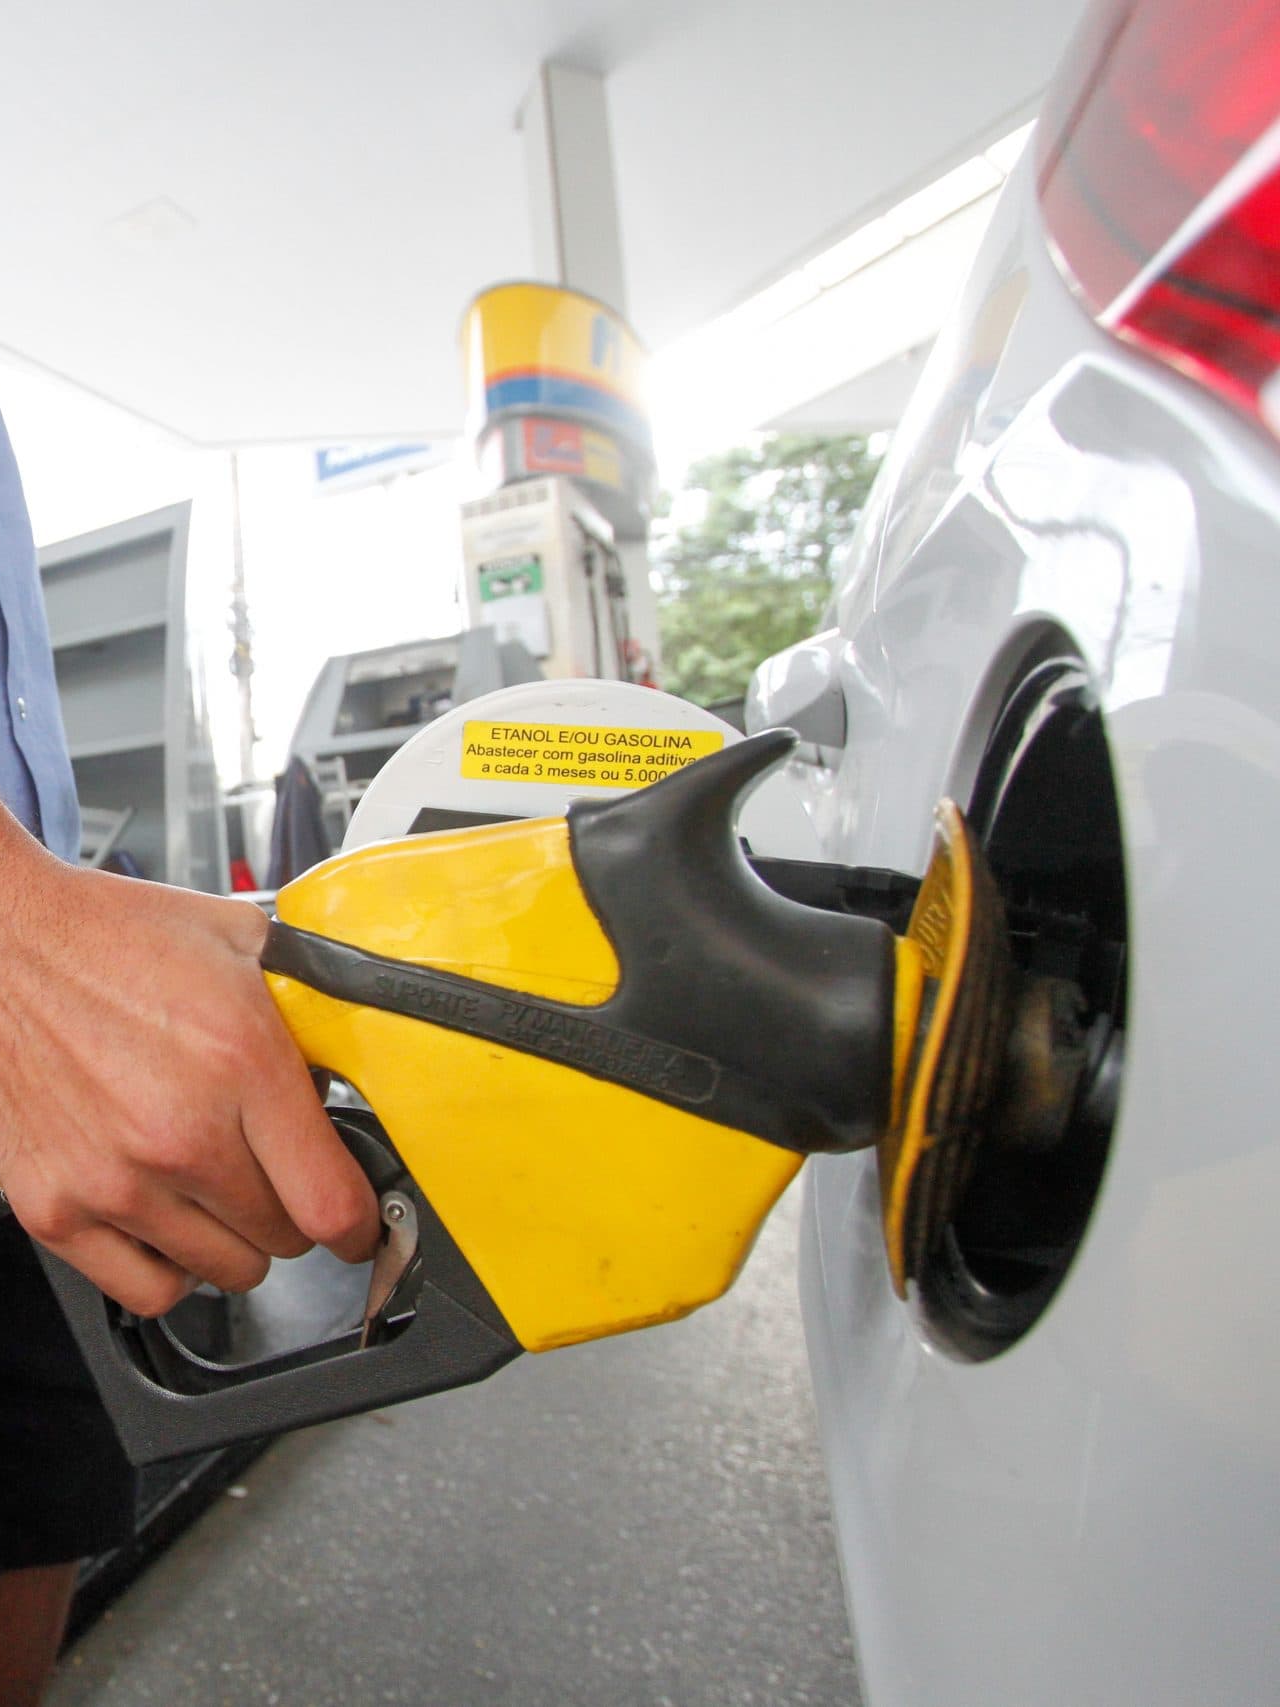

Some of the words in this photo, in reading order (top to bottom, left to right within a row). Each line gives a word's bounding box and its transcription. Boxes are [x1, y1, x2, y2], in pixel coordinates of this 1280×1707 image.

[490, 727, 554, 744] ETANOL
[558, 731, 600, 745] E/OU
[604, 732, 693, 749] GASOLINA
[466, 743, 539, 759] Abastecer
[542, 750, 574, 761] com
[578, 750, 642, 765] gasolina
[645, 752, 697, 767] aditiva
[481, 764, 491, 774] a
[494, 762, 530, 776] cada
[533, 764, 543, 776] 3
[547, 767, 596, 780] meses
[600, 770, 620, 781] ou
